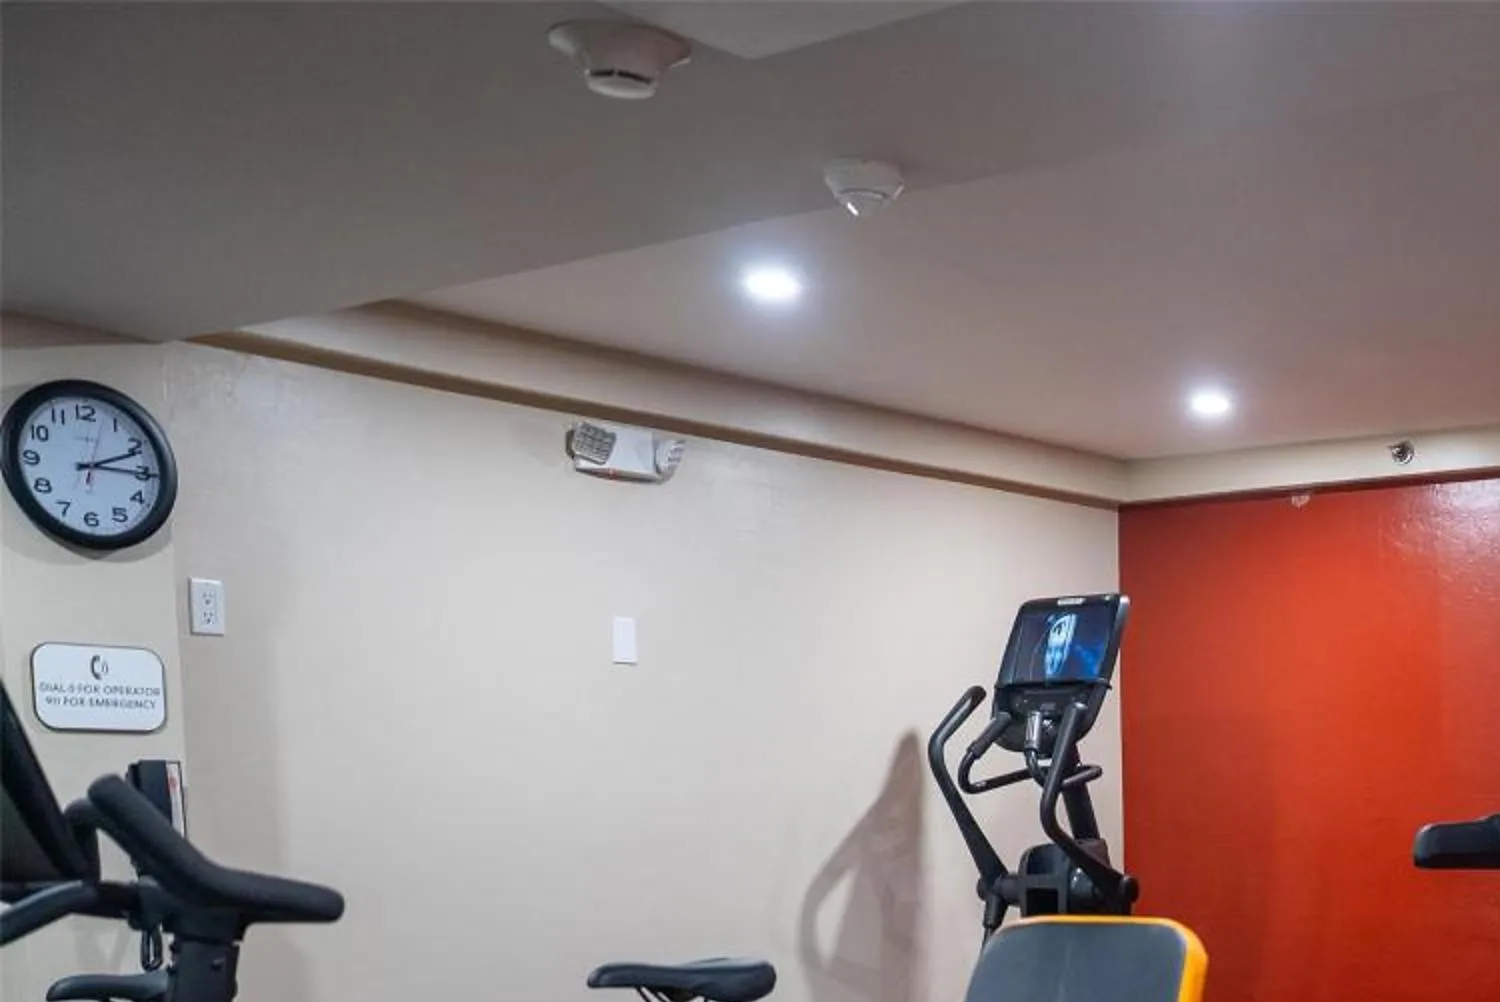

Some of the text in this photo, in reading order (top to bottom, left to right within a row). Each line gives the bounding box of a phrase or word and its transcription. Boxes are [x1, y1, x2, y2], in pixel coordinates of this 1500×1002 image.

[51, 407, 65, 425] 11
[75, 403, 96, 423] 12
[31, 424, 49, 442] 10
[113, 418, 117, 432] 1
[127, 438, 143, 455] 2
[22, 449, 40, 466] 9
[134, 465, 150, 481] 3
[34, 477, 52, 494] 8
[130, 490, 144, 504] 4
[56, 500, 72, 516] 7
[111, 507, 128, 523] 5
[83, 511, 99, 527] 6
[78, 684, 100, 694] FOR
[104, 684, 161, 697] OPERATOR
[62, 696, 85, 707] FOR
[89, 697, 156, 710] EMERGENCY
